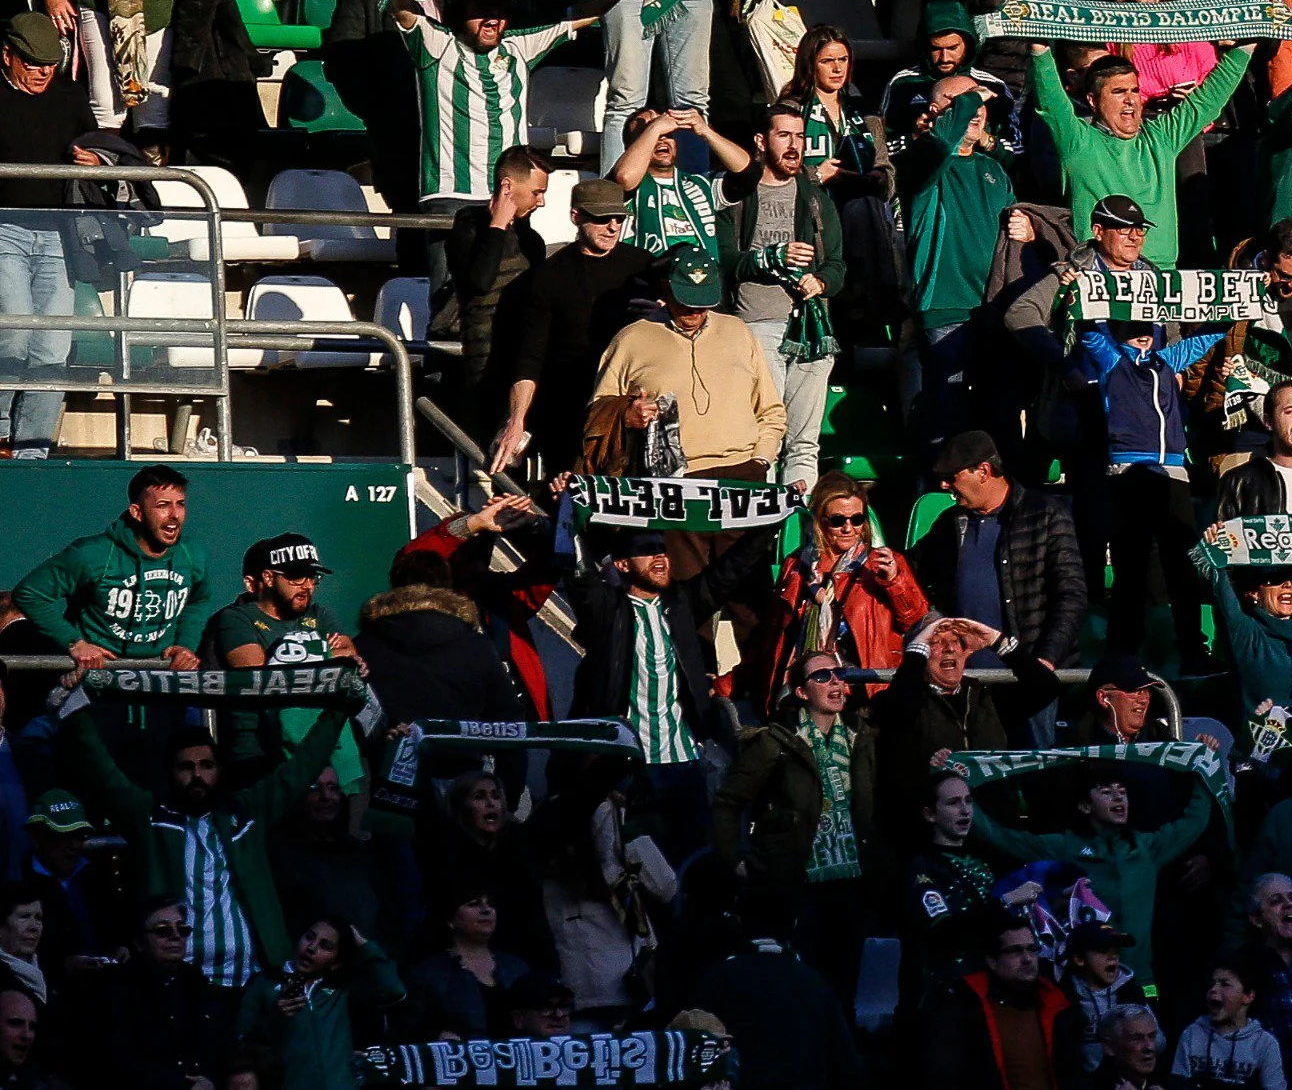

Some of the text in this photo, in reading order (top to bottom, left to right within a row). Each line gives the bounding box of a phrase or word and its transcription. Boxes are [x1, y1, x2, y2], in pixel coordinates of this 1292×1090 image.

[1028, 2, 1262, 26] REAL BETIS BALOMPIE
[1086, 270, 1265, 303] REAL BET
[345, 485, 397, 502] A 127
[270, 547, 294, 565] CITY
[106, 587, 133, 620] 19
